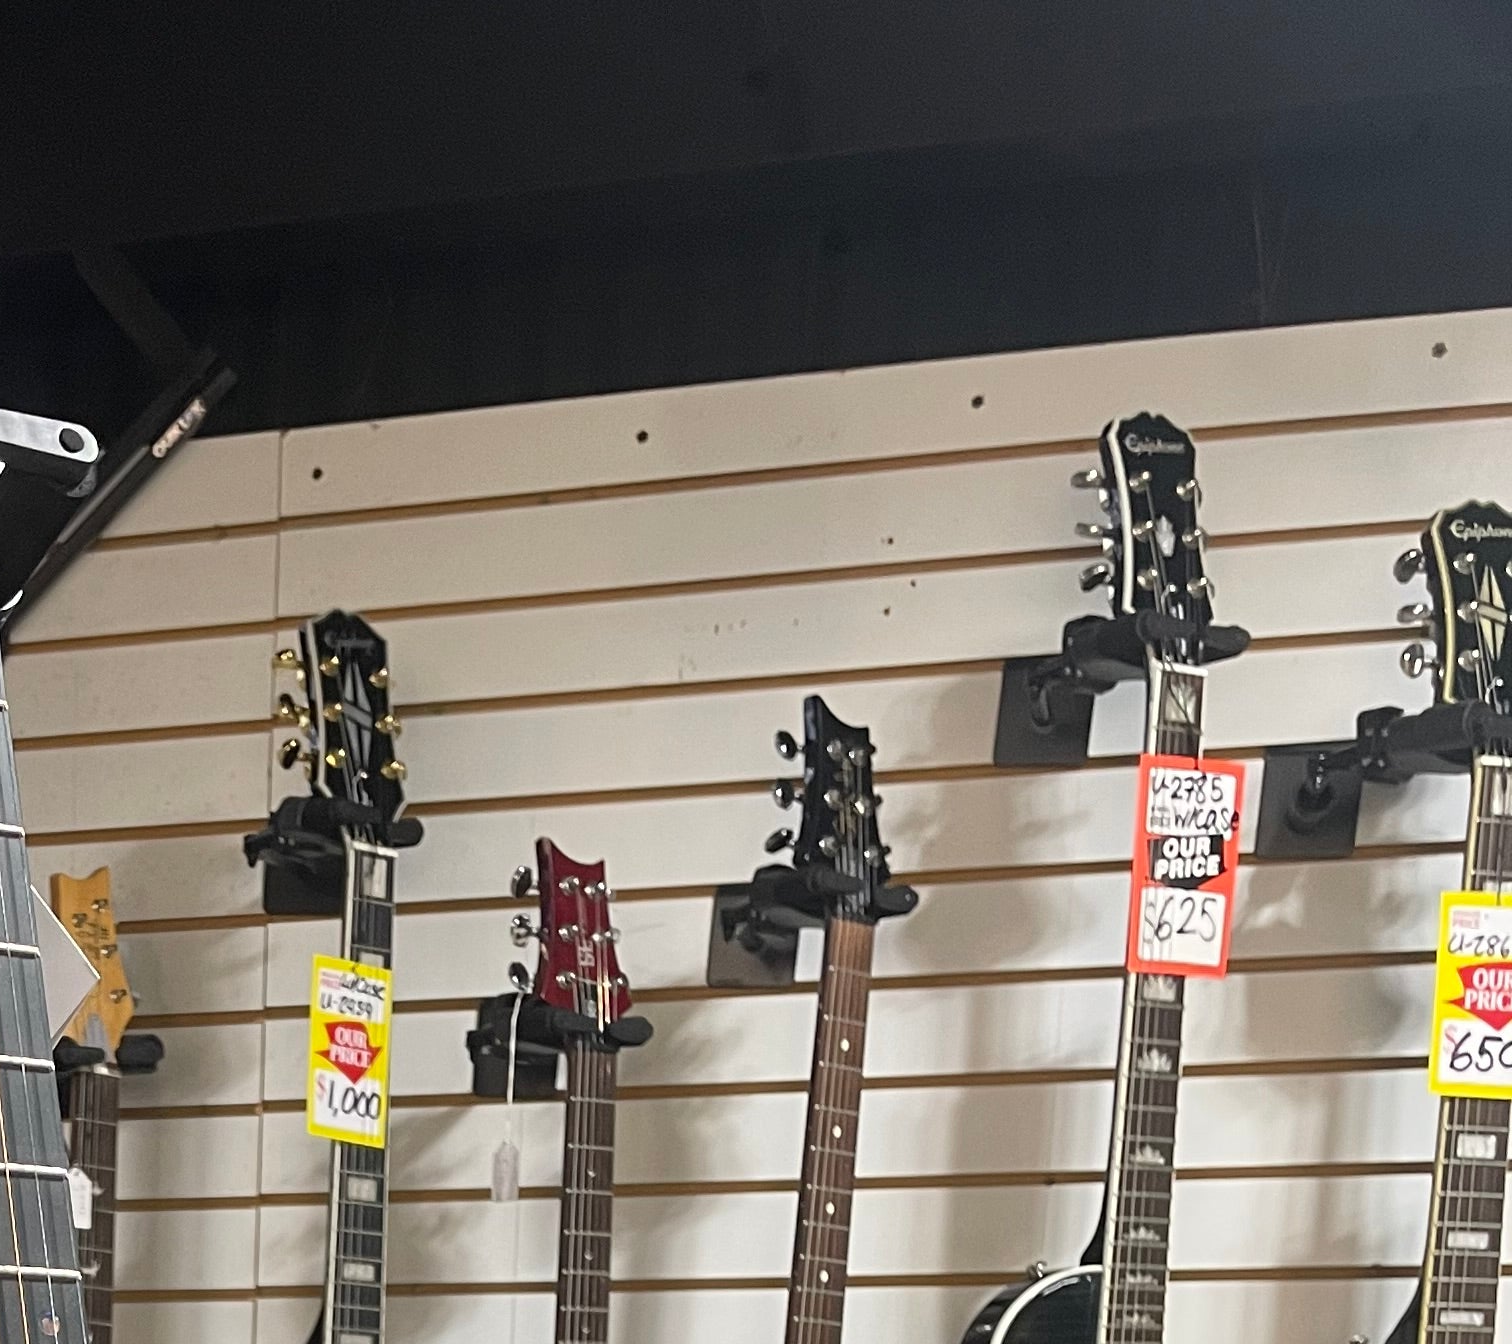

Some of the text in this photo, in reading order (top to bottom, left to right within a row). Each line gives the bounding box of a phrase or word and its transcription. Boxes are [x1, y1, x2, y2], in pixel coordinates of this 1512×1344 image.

[1162, 838, 1211, 858] OUR
[1154, 854, 1221, 881] PRICE
[335, 1026, 368, 1050] OUR
[328, 1043, 373, 1069] PRICE
